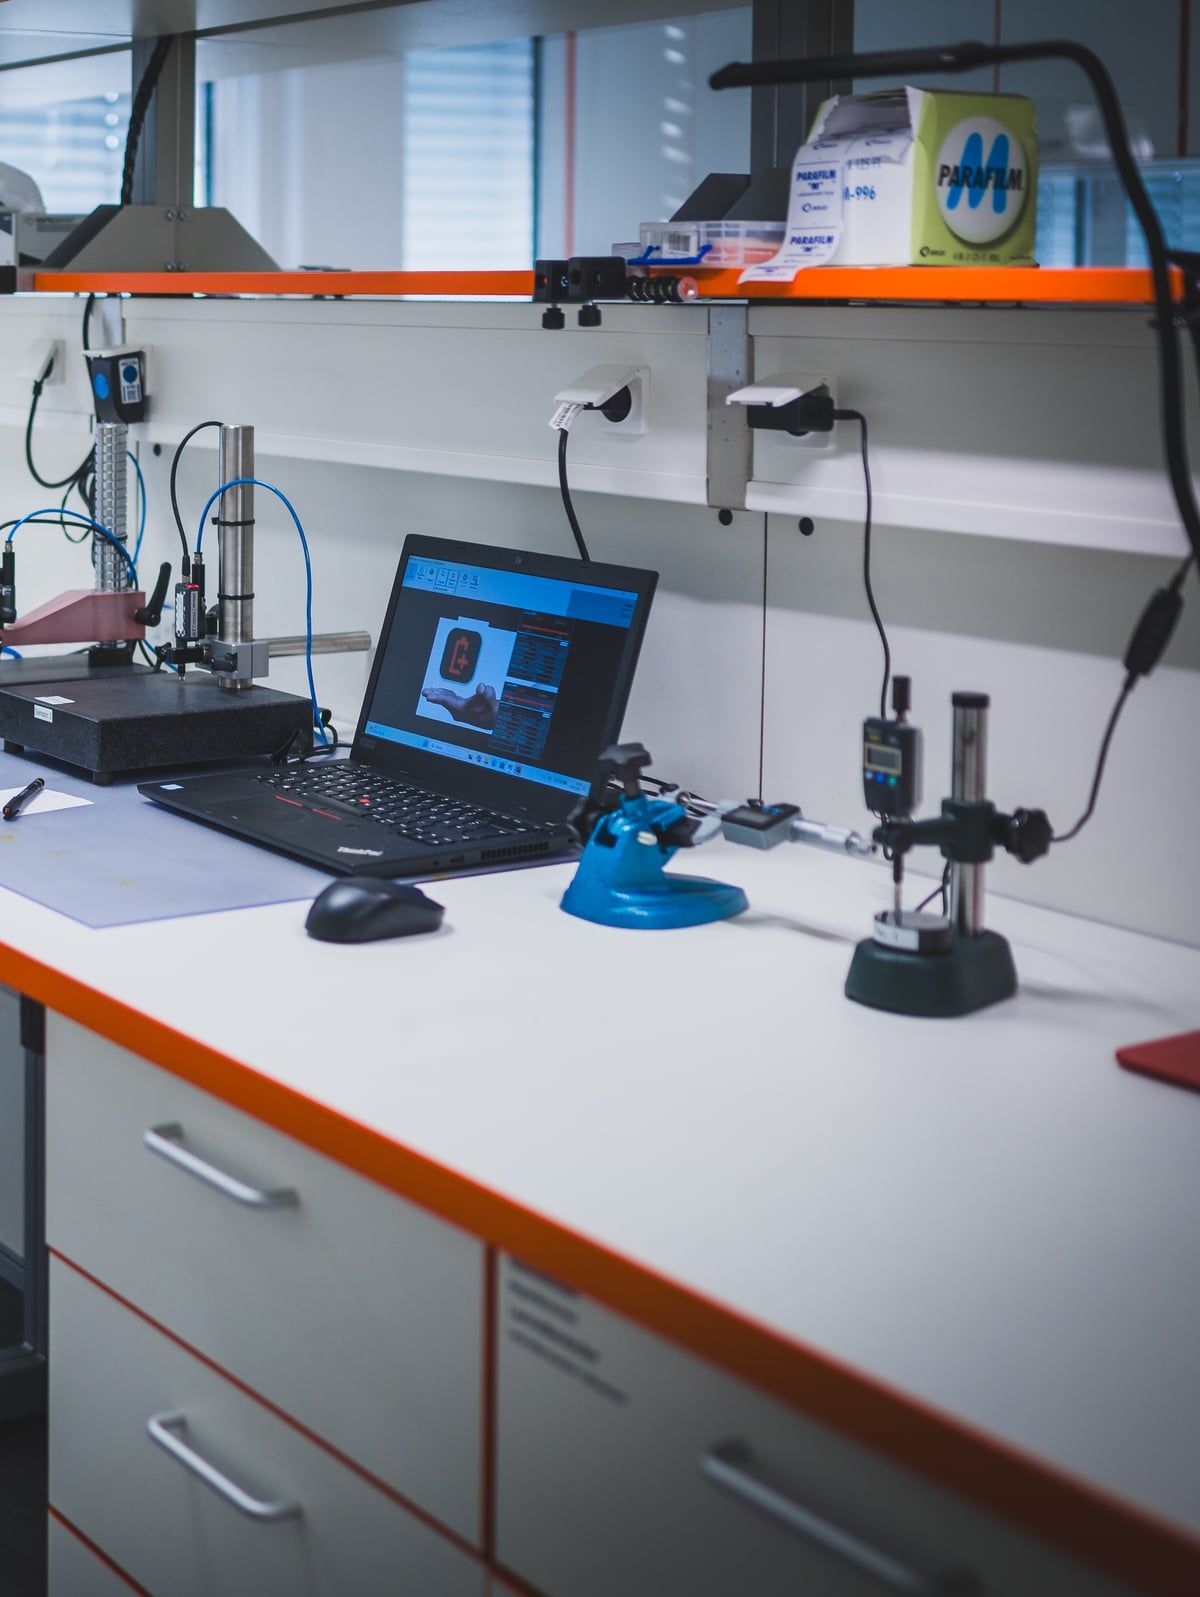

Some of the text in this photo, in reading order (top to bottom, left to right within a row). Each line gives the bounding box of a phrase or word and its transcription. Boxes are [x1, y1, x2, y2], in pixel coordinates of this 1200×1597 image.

[796, 169, 836, 181] PARAFILM
[937, 164, 1023, 191] PARAFILM
[789, 235, 834, 245] PARAFILM
[337, 846, 384, 857] ThinkPad
